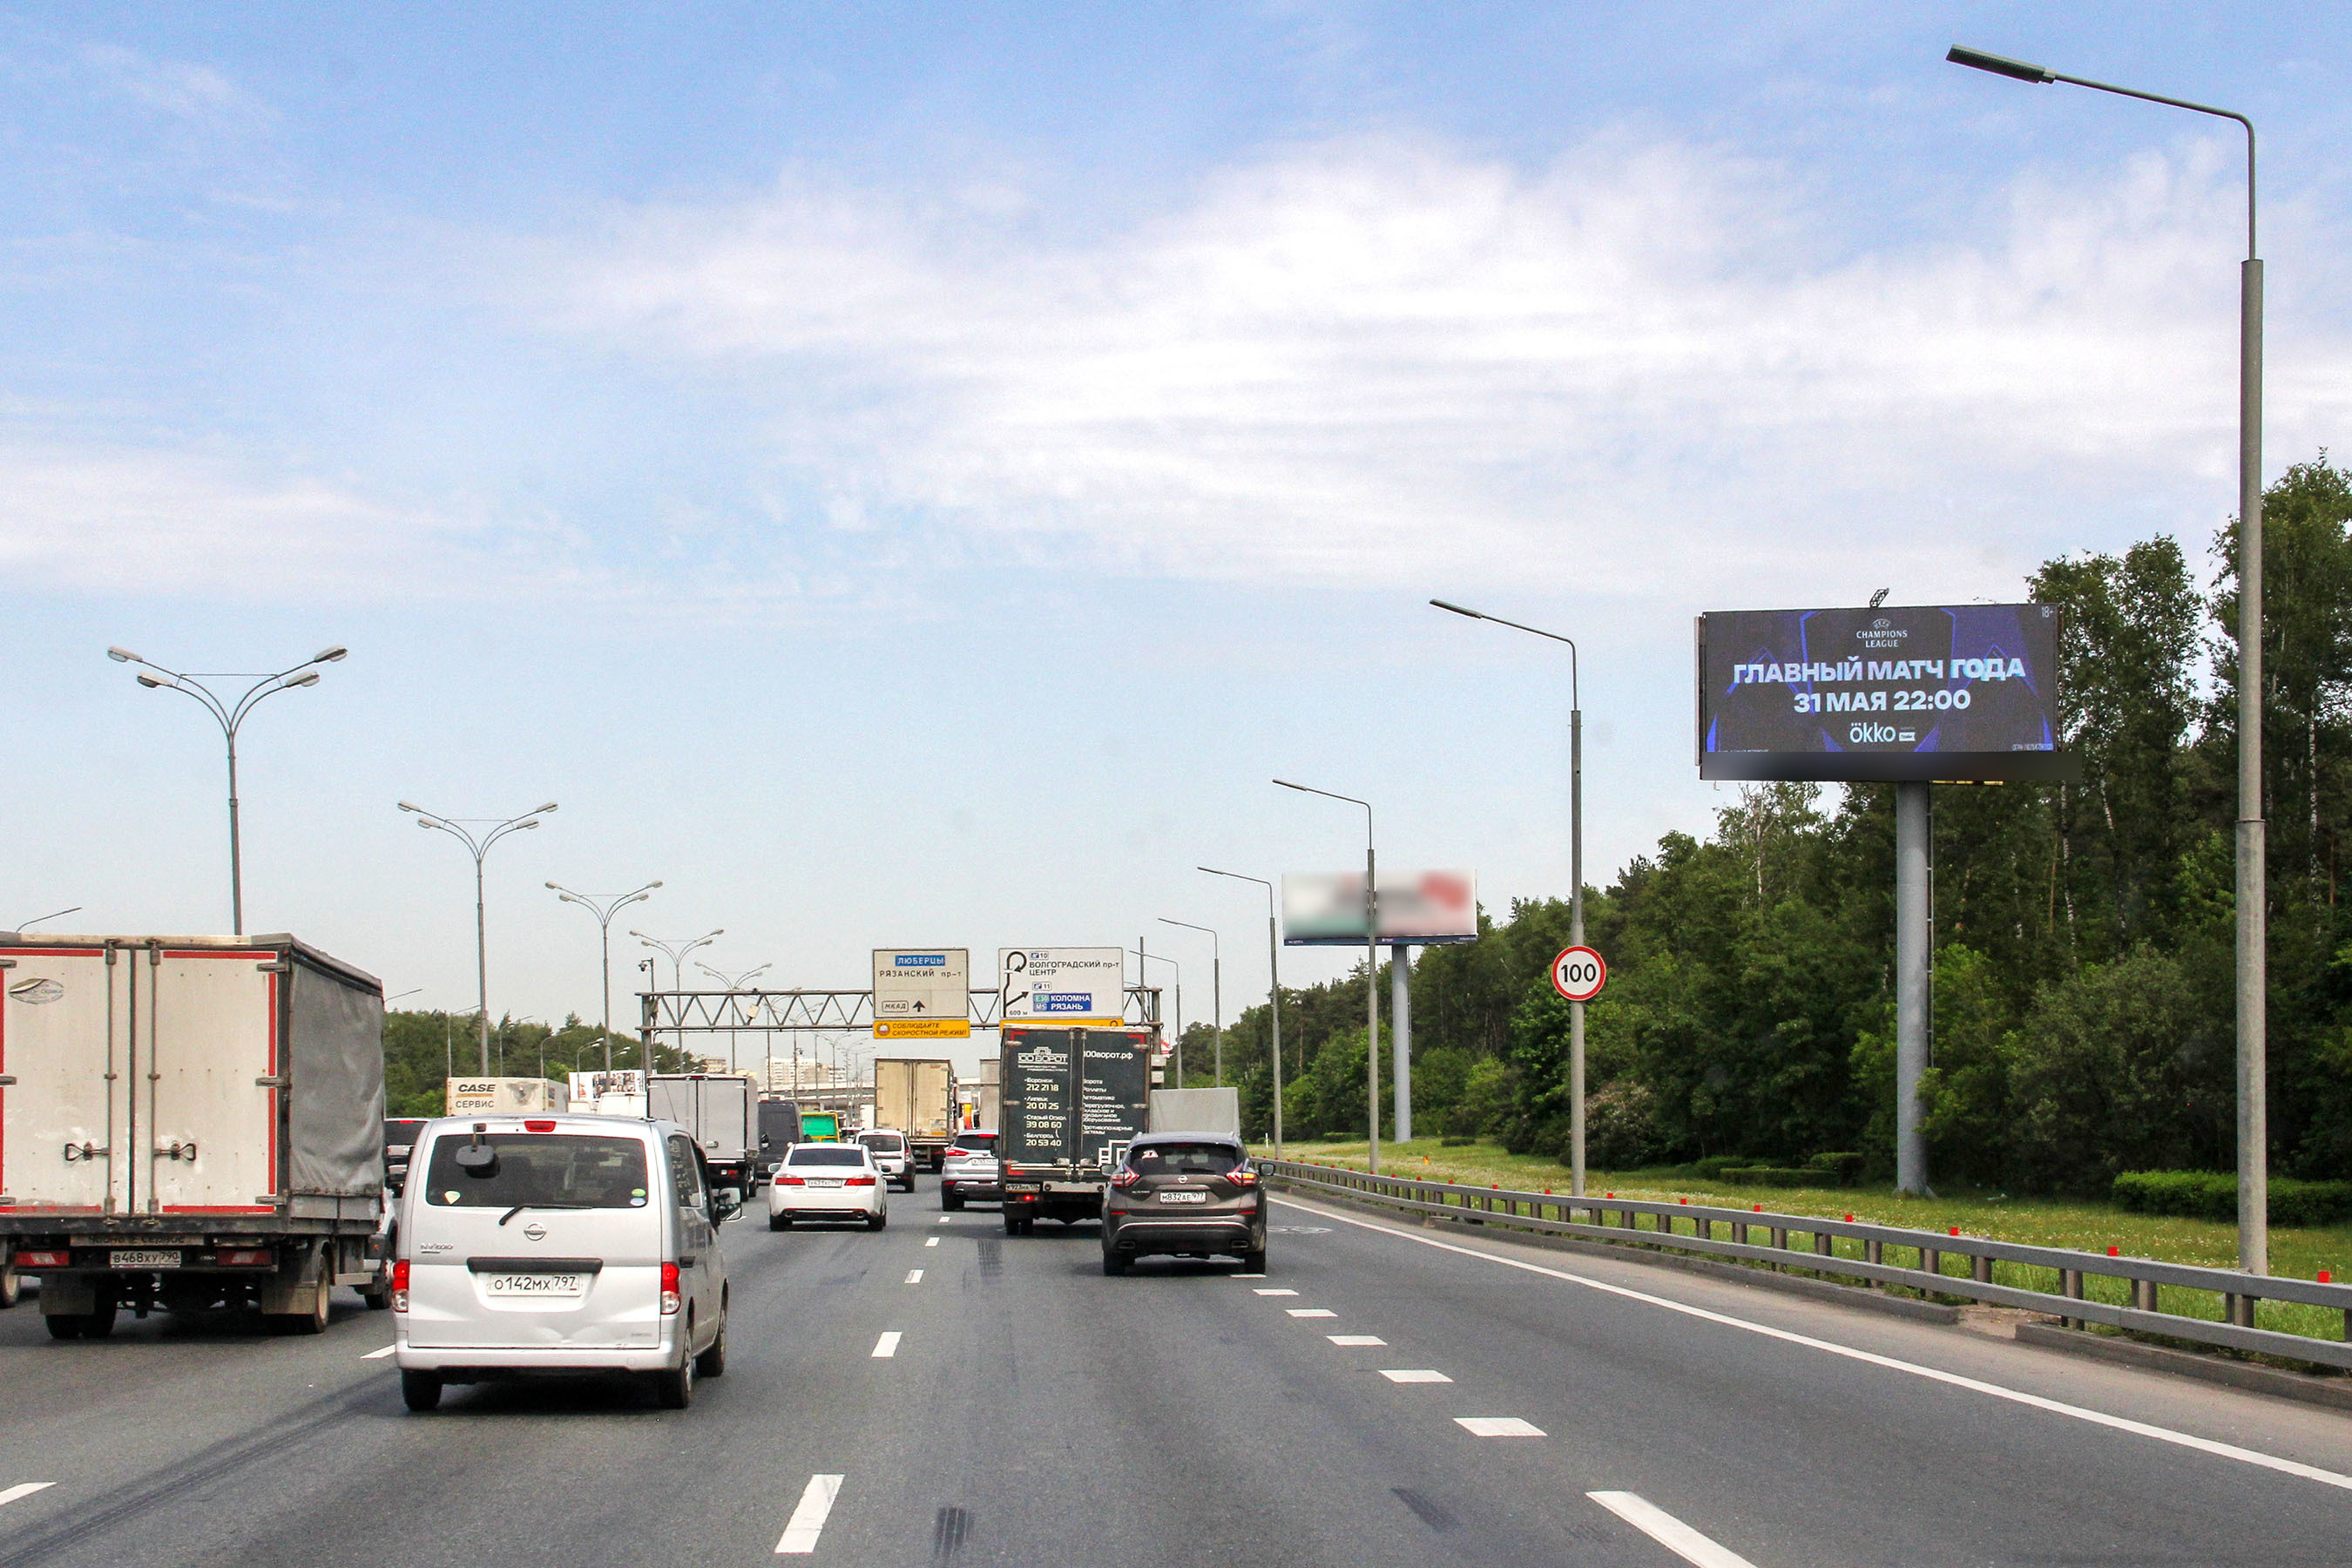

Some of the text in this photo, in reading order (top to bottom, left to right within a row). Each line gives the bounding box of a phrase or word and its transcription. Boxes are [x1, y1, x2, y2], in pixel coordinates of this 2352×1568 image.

[1856, 630, 1908, 639] CHAMPIONS
[1734, 656, 2026, 684] ГЛАВНЫЙ МАТЧ ГОДА
[1794, 689, 1970, 713] 31 МАЯ 22:00
[897, 956, 944, 965] ЛЮБЕРЦЫ
[880, 969, 935, 977] РЯЗАНСКИЙ
[1561, 963, 1596, 983] 100
[1083, 1051, 1133, 1059] 100ворот.рф
[458, 1084, 497, 1092] CASE
